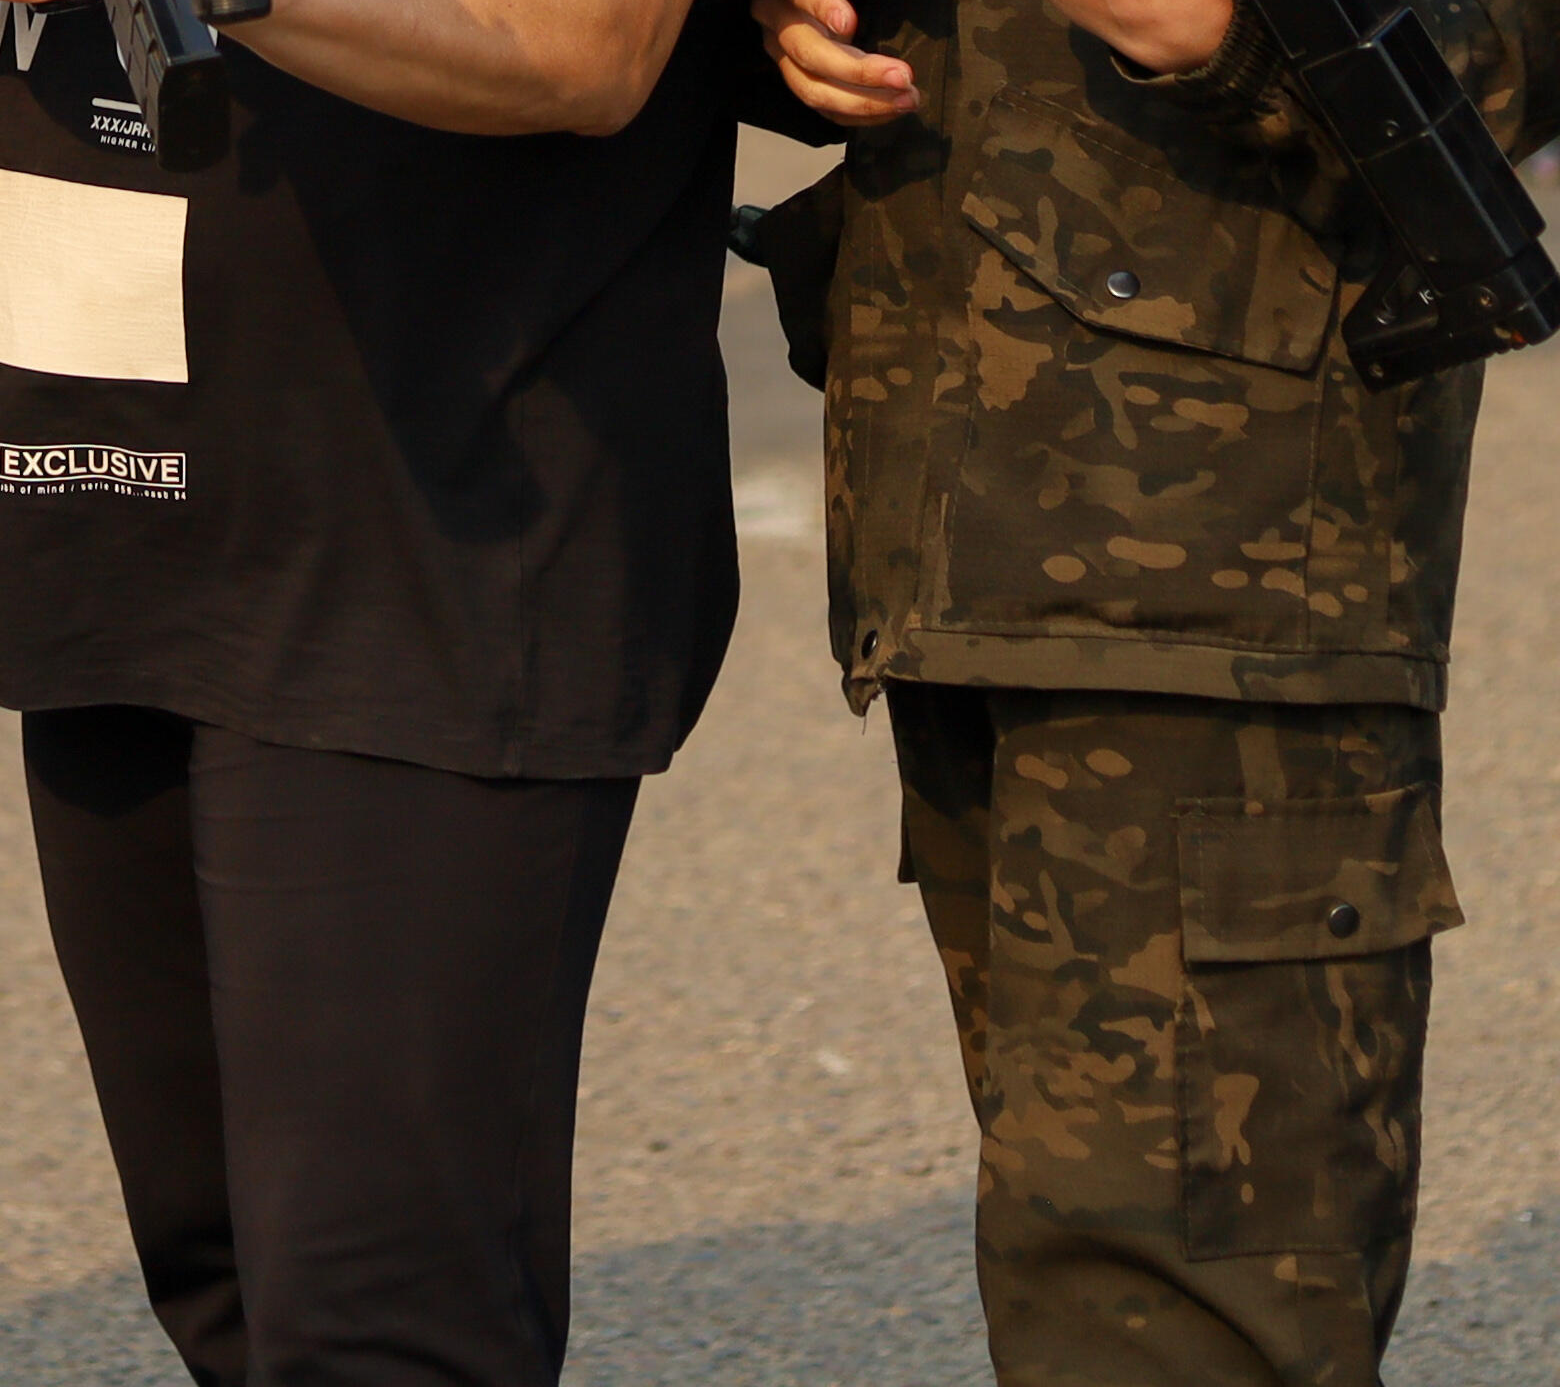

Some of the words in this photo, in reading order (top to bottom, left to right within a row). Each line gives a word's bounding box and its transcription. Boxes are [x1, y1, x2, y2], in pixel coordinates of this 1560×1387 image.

[141, 142, 157, 153] LI
[3, 448, 181, 484] EXCLUSIVE
[19, 484, 32, 495] of
[37, 483, 65, 495] mind
